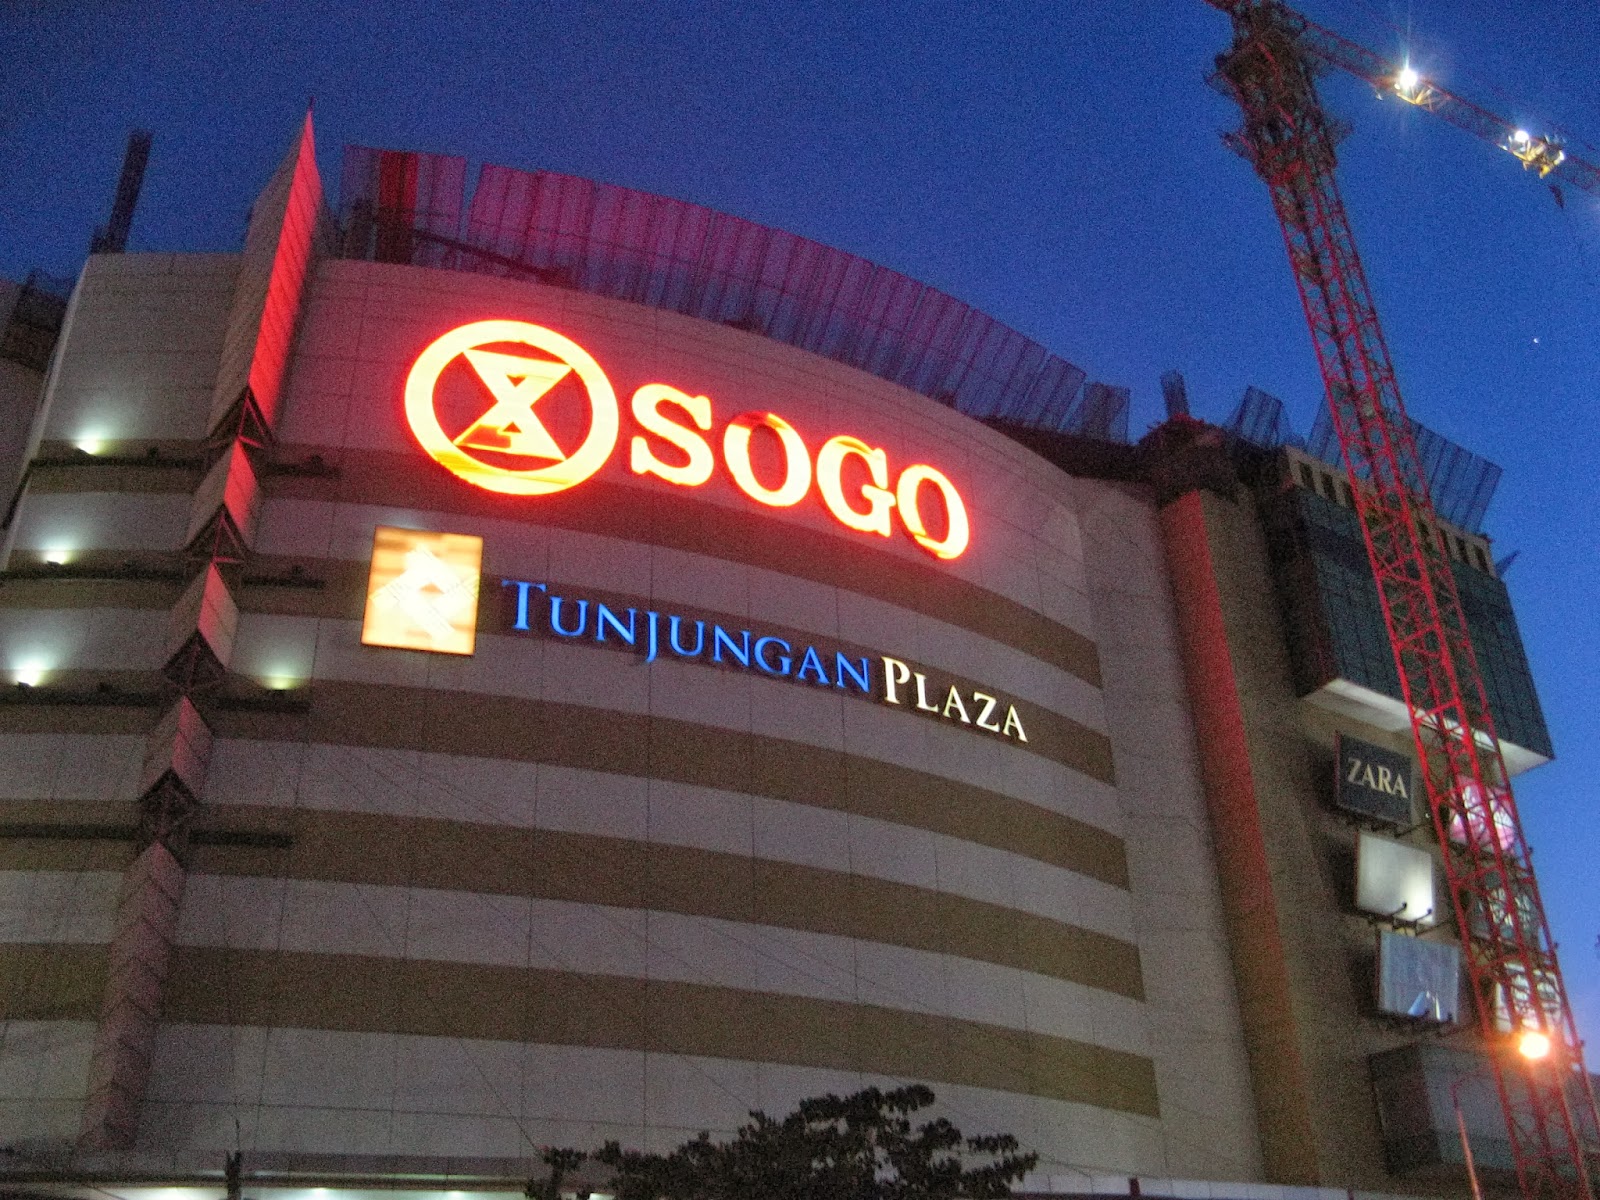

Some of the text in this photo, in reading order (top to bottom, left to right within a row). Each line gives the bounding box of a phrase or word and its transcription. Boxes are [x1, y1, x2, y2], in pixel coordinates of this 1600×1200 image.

[631, 383, 969, 560] SOGO
[501, 579, 1028, 743] TUNJUNGAN PLAZA
[1347, 757, 1408, 799] ZARA
